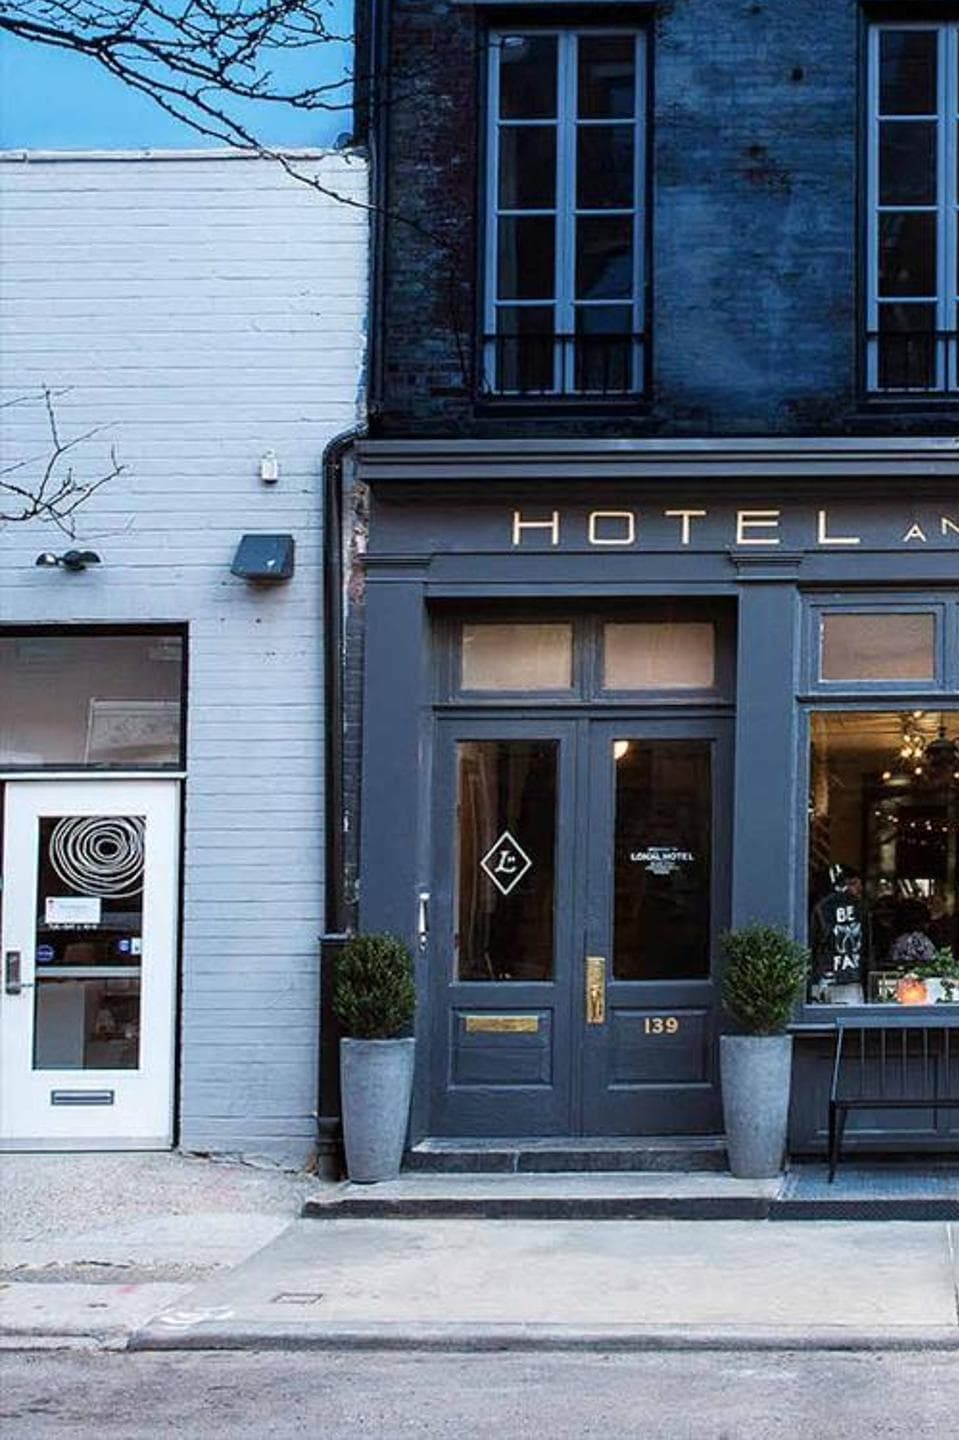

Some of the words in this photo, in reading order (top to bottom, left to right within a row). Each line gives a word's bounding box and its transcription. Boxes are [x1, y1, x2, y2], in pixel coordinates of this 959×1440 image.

[512, 510, 861, 545] HOTEL
[662, 851, 695, 861] HOTEL
[836, 905, 856, 923] BE
[644, 1017, 679, 1034] 139
